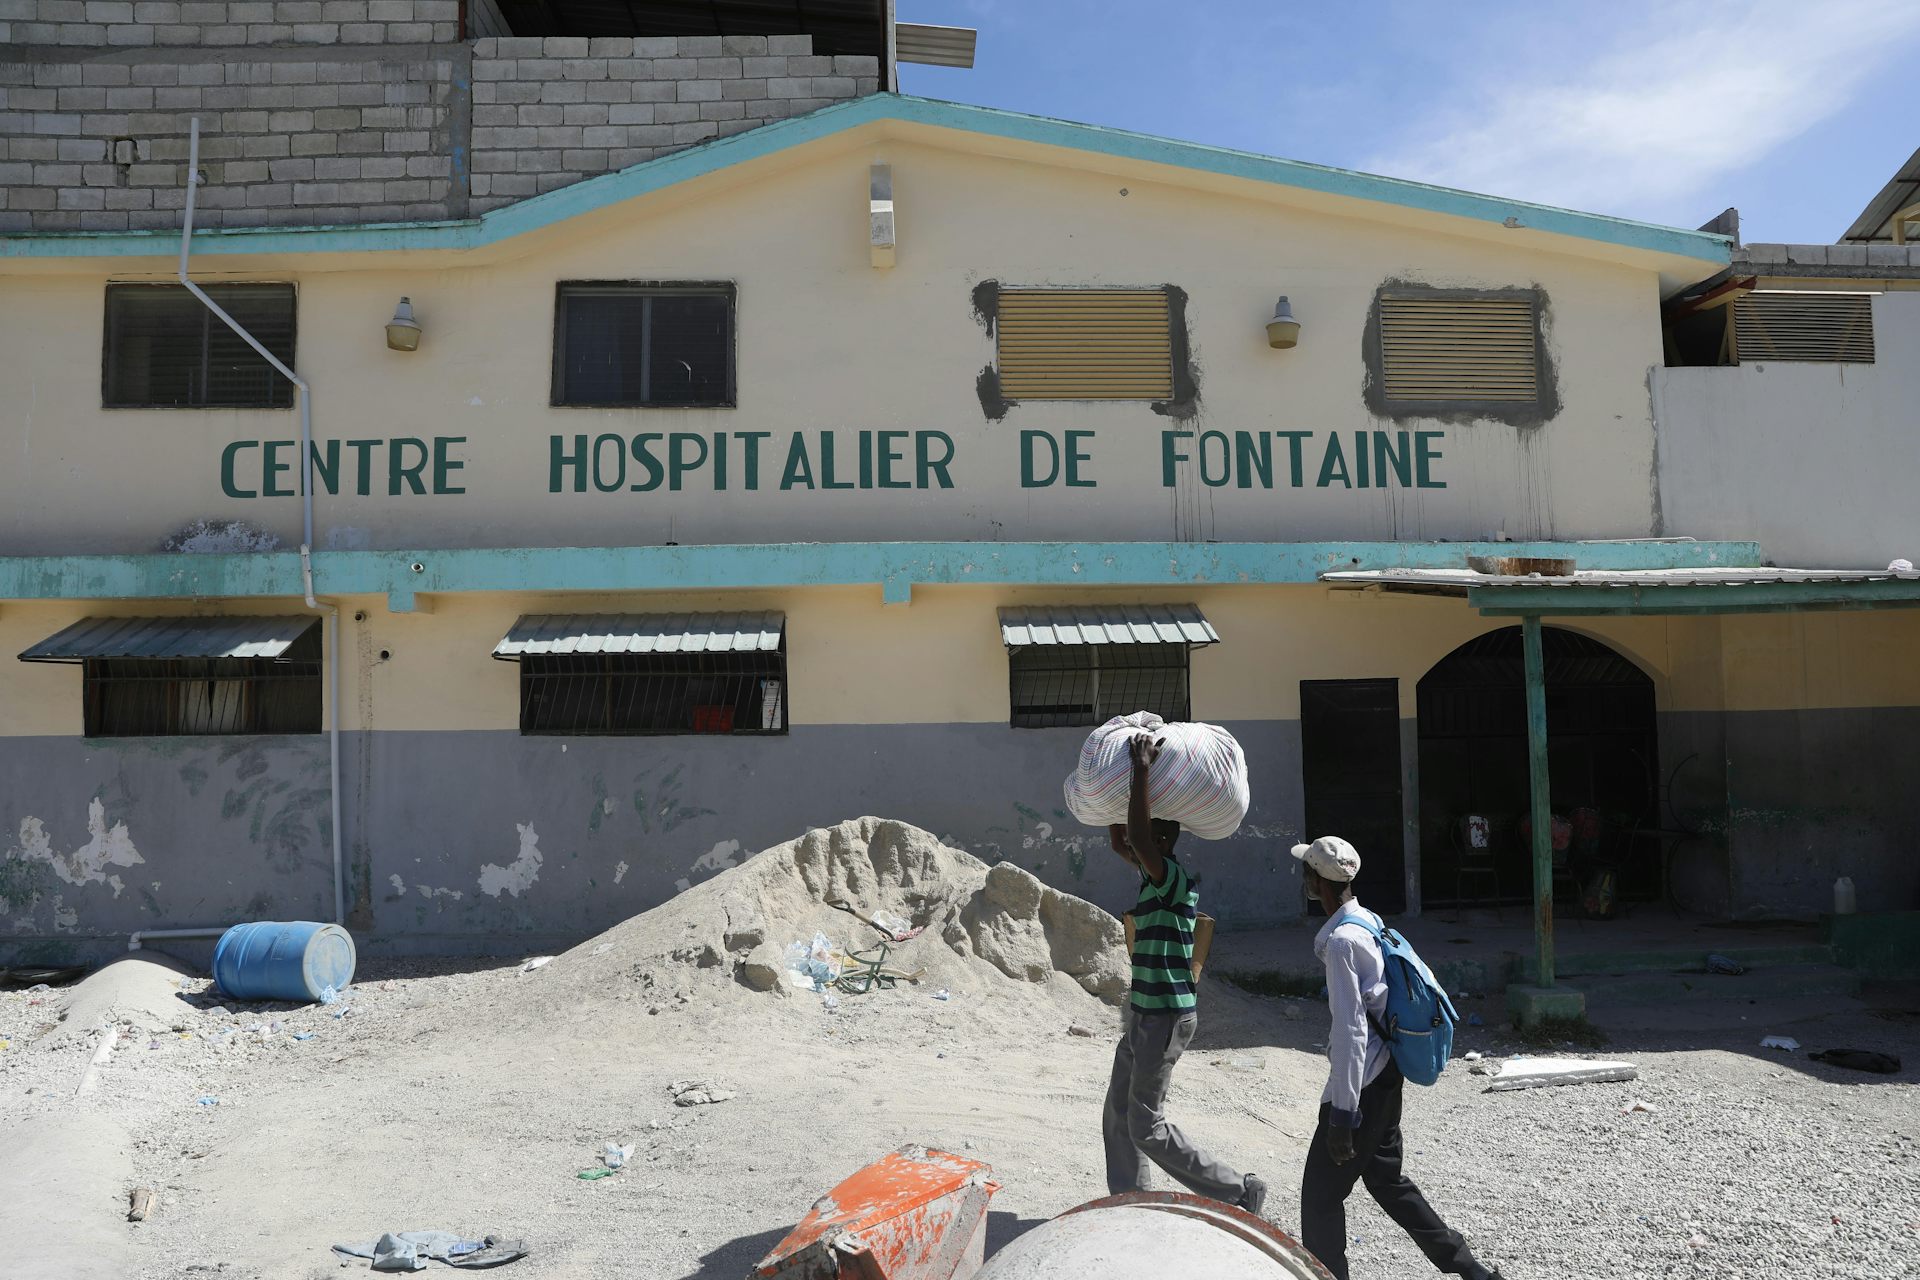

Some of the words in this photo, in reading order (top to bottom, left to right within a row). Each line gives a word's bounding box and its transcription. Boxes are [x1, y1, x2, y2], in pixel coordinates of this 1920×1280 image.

[221, 436, 467, 498] CENTRE
[549, 430, 955, 493] HOSPITALIER
[1020, 429, 1098, 489] DE
[1161, 429, 1448, 489] FONTAINE
